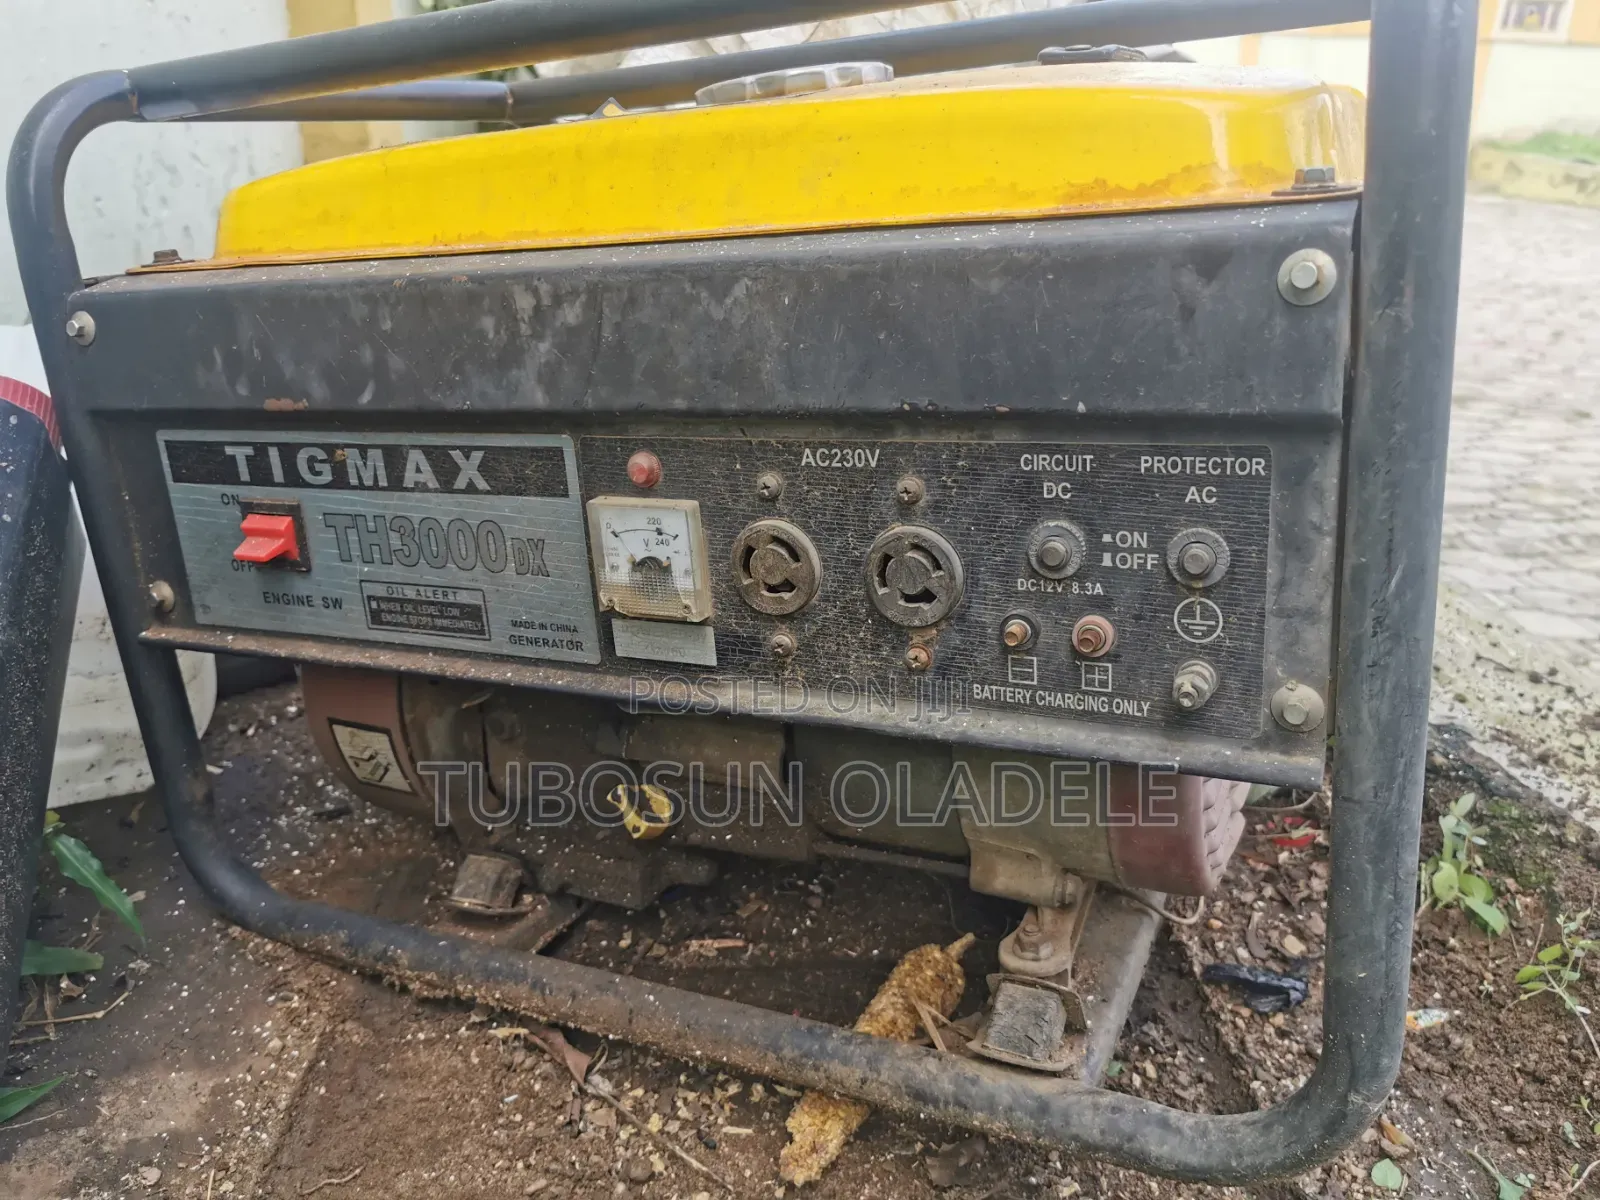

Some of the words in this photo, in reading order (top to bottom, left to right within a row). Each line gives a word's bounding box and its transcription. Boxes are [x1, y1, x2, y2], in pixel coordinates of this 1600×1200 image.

[800, 447, 881, 468] AC230V
[1019, 453, 1094, 472] CIRCUIT
[1139, 455, 1267, 476] PROTECTOR
[224, 445, 492, 491] TIGMAX
[220, 493, 241, 506] ON
[1042, 481, 1072, 500] DC
[1184, 485, 1218, 504] AC
[646, 517, 662, 526] 220
[655, 537, 670, 547] 240
[1115, 531, 1149, 549] ON
[1115, 552, 1159, 570] OFF
[385, 585, 409, 597] OIL
[414, 587, 459, 601] ALERT
[1016, 578, 1063, 593] DC12V
[1071, 581, 1104, 596] 8.3A
[262, 591, 315, 608] ENGINE
[321, 596, 343, 610] SW
[442, 606, 461, 617] LOW
[510, 618, 537, 632] MADE
[537, 621, 548, 632] IN
[549, 622, 579, 635] CHINA
[508, 633, 585, 652] GENERATOR
[972, 683, 1032, 706] BATTERY
[1035, 689, 1110, 713] CHARGING
[1112, 698, 1151, 718] ONLY
